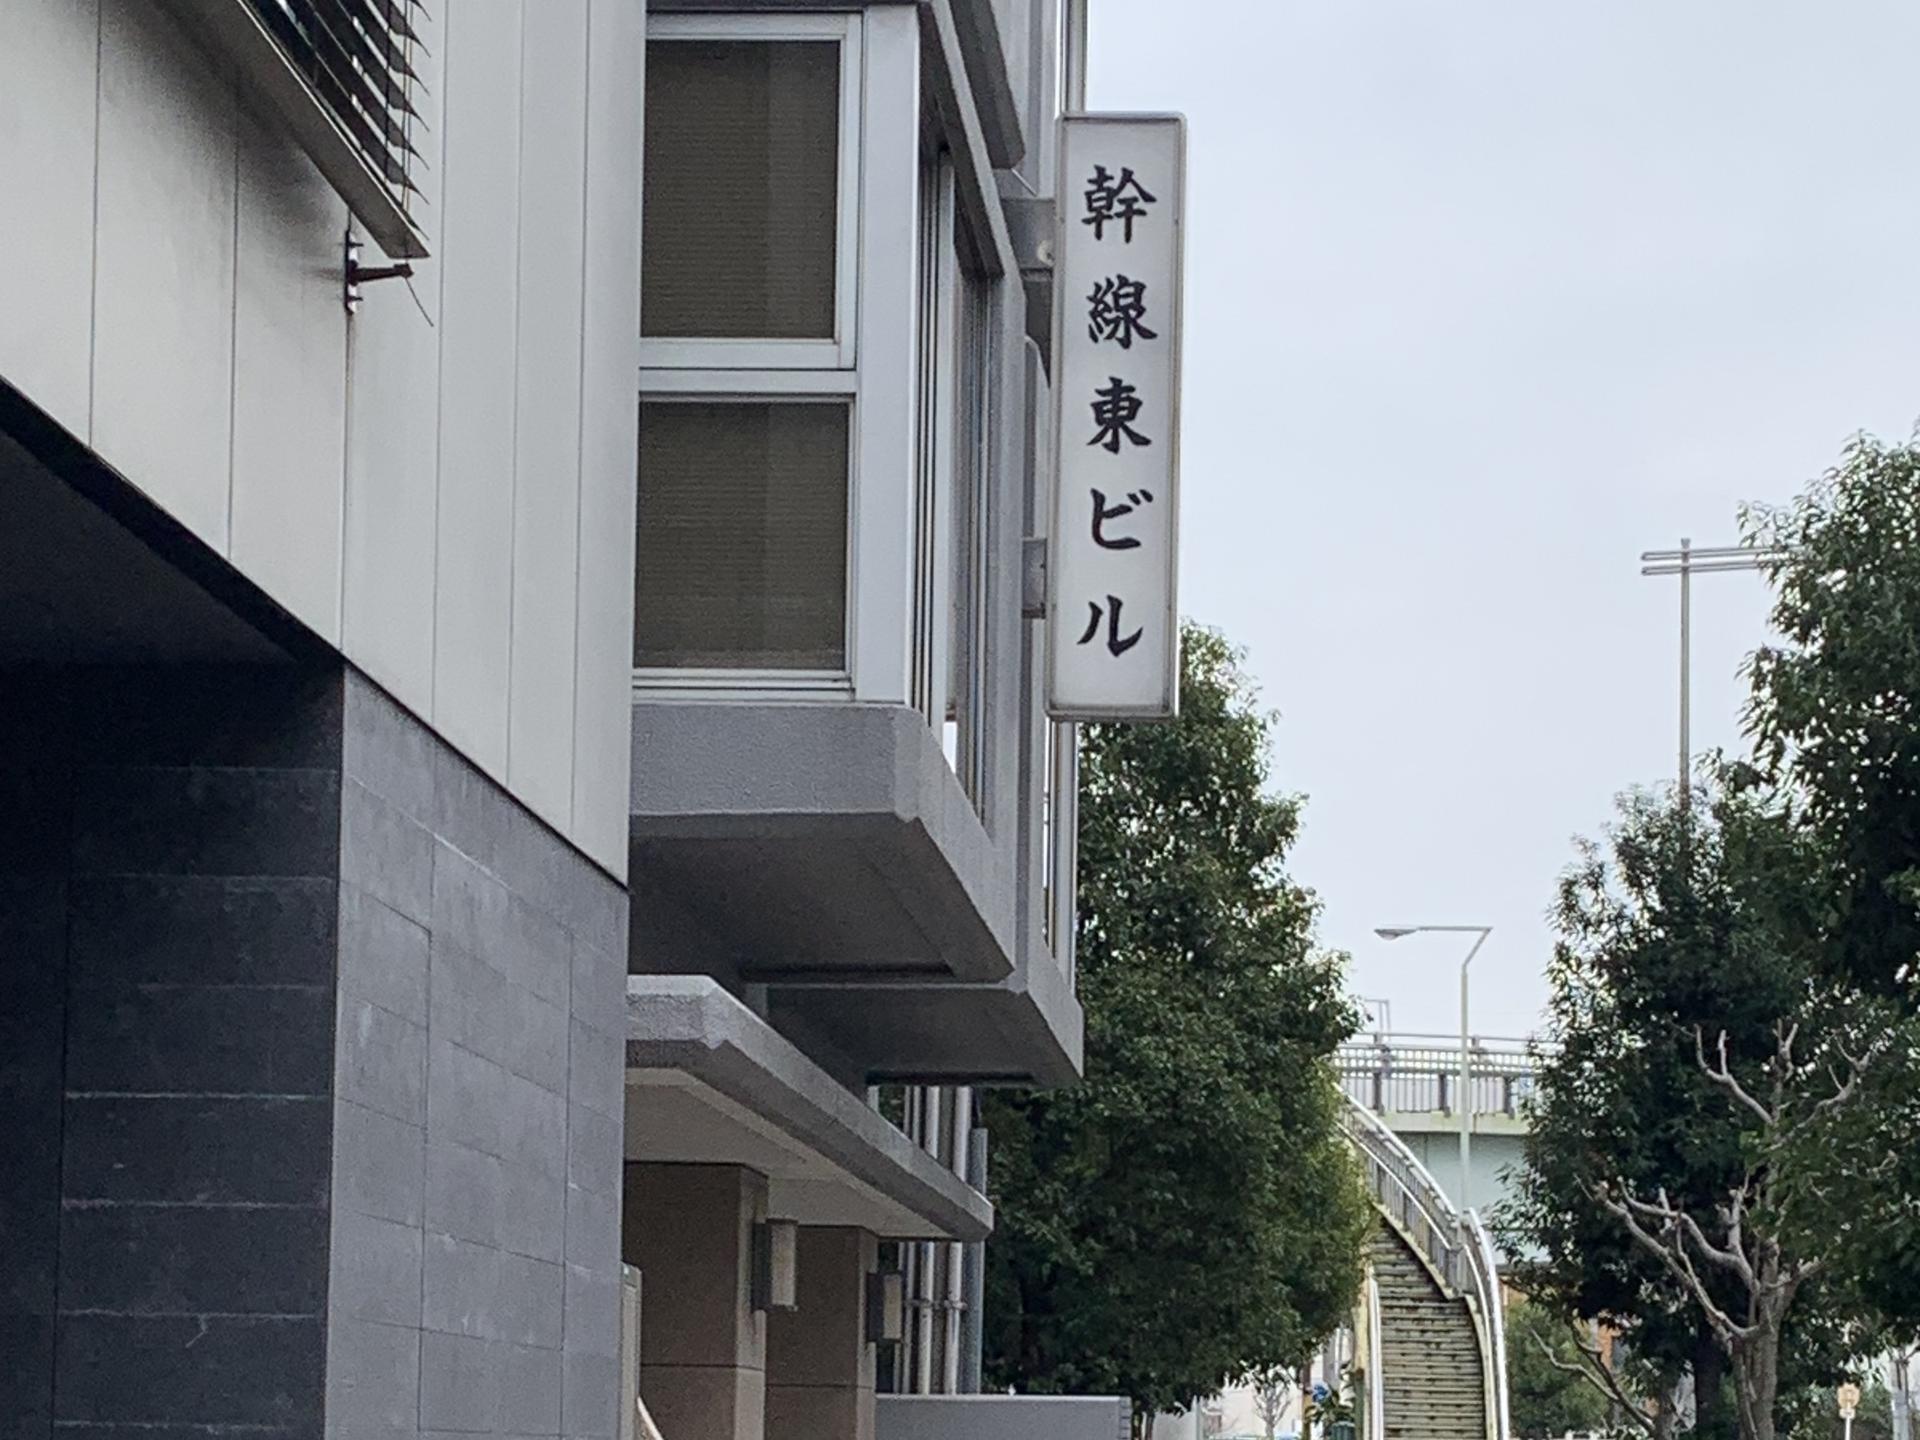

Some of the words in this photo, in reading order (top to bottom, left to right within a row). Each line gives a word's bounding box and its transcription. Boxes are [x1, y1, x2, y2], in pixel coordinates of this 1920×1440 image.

[1077, 164, 1159, 658] 幹線東ビル
